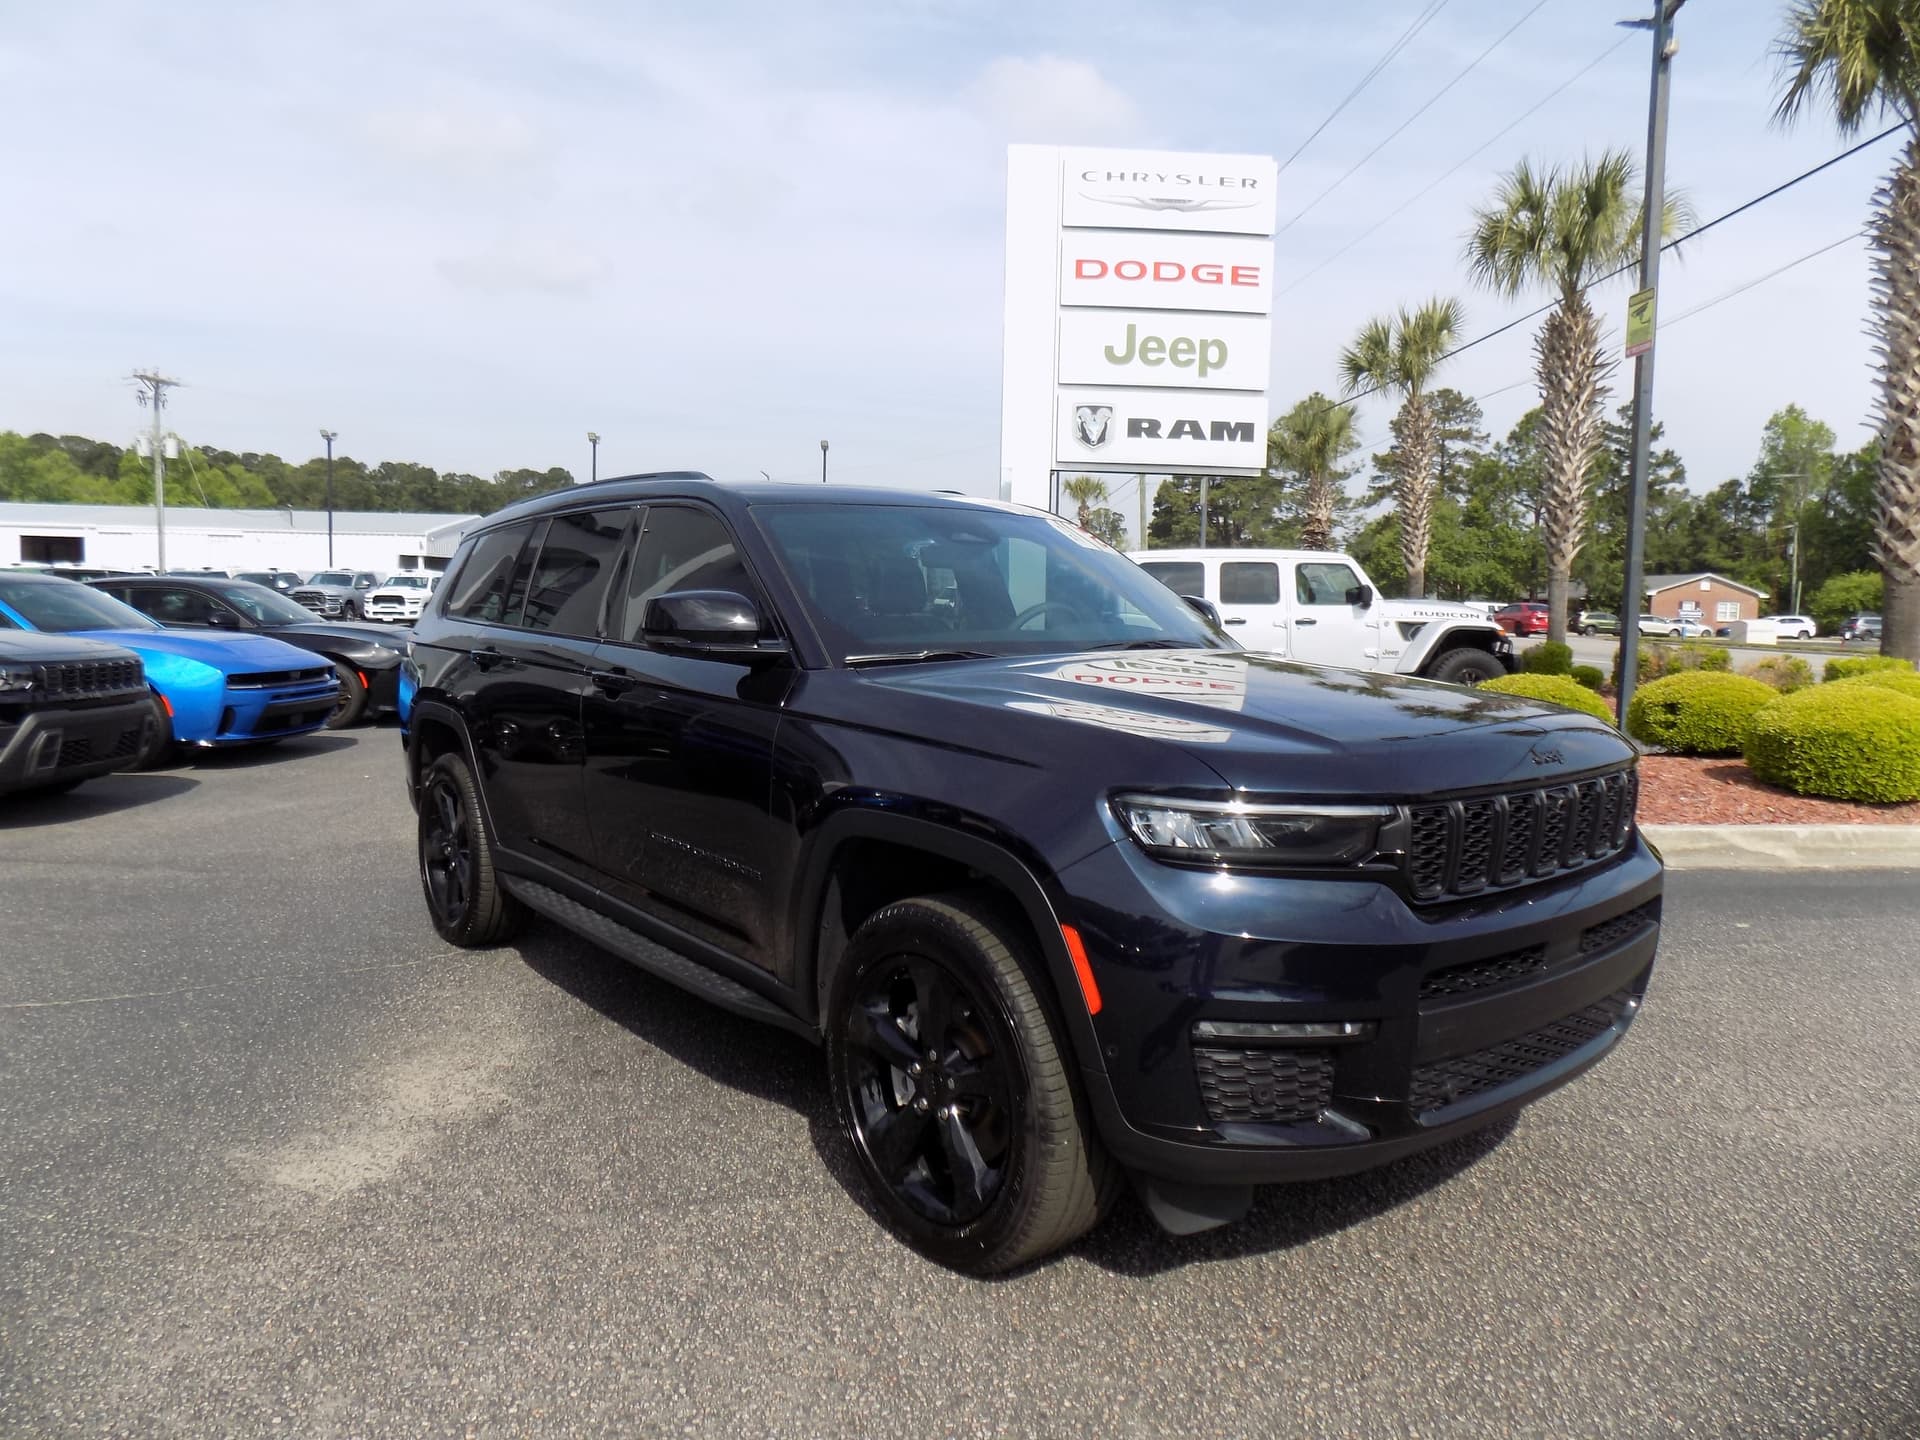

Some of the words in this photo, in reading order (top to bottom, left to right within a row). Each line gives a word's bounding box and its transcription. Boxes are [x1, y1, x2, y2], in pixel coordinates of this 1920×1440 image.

[1081, 170, 1258, 189] CHRYSLER
[1075, 259, 1260, 286] DODGE
[1104, 323, 1228, 378] Jeep
[1127, 417, 1255, 443] RAM
[1413, 605, 1480, 619] RUBICON
[1382, 649, 1400, 657] Jeep
